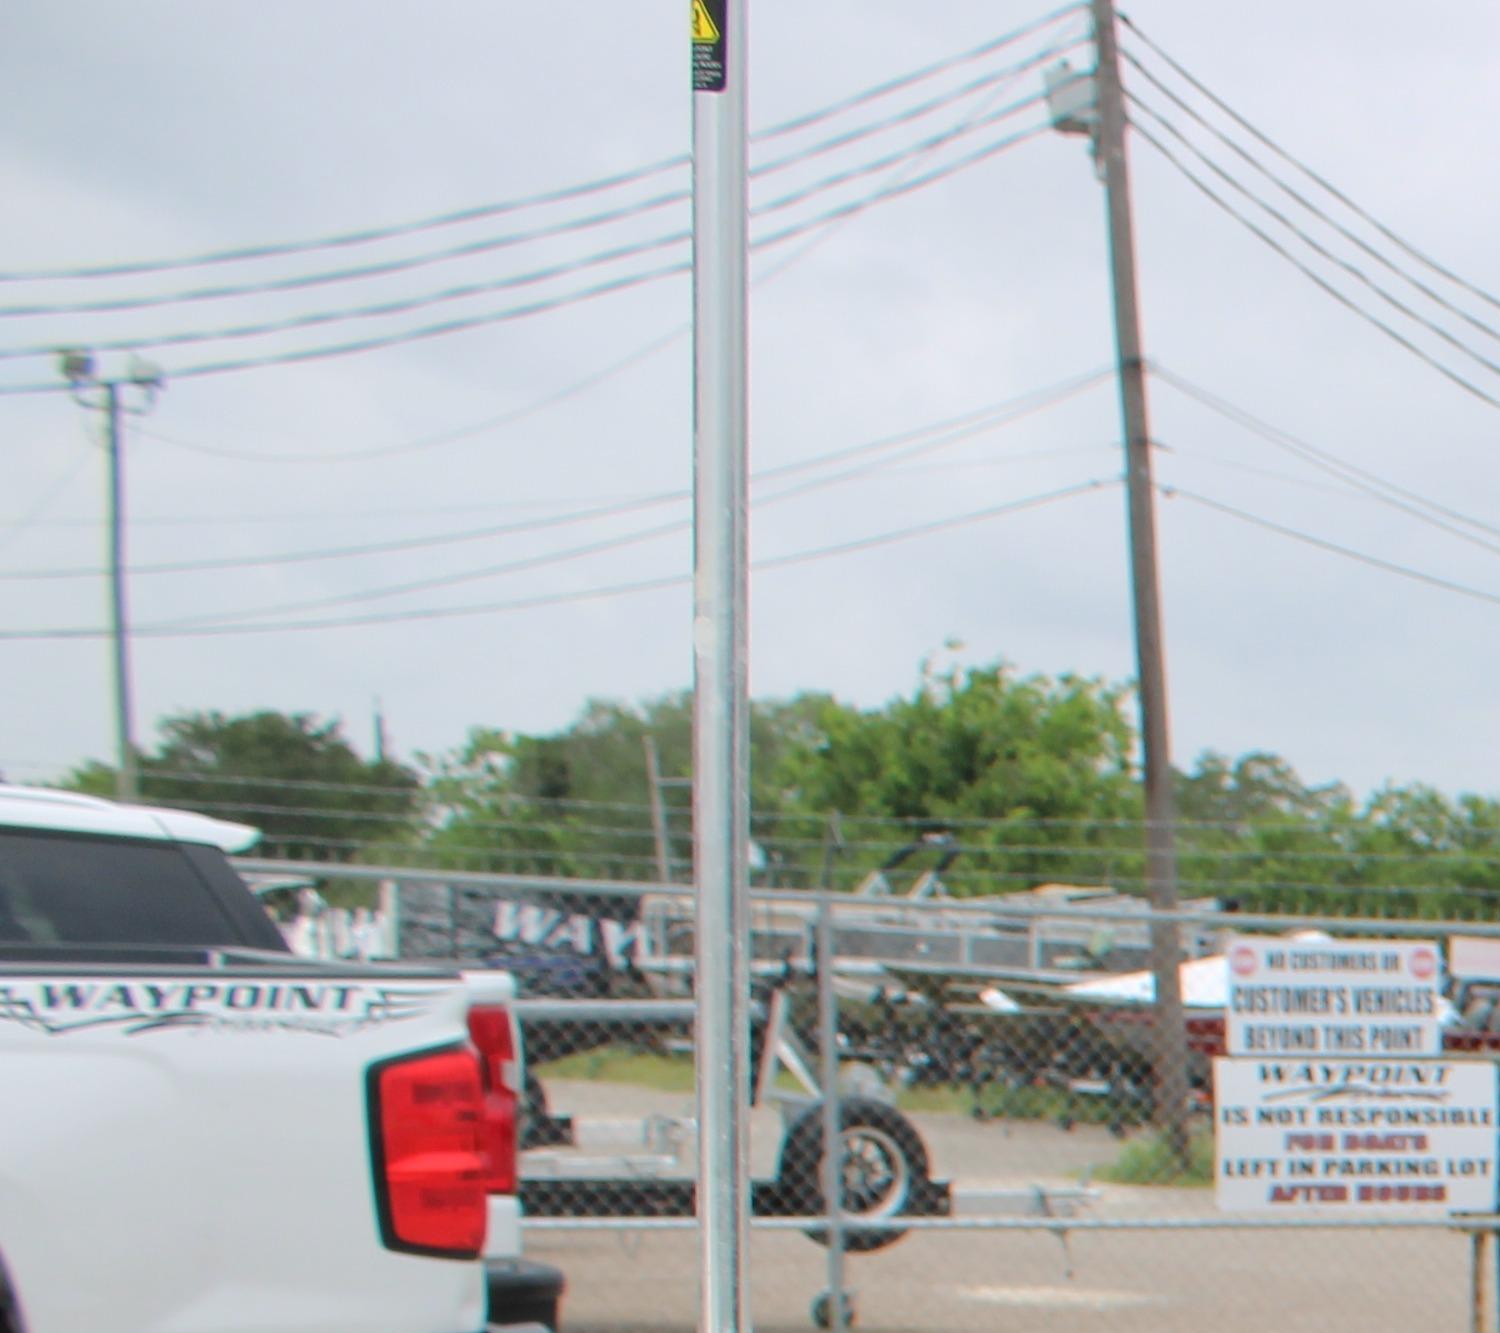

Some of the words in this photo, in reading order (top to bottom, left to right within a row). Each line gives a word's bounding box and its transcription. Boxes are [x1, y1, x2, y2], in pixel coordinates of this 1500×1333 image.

[1289, 951, 1377, 970] CUSTOMERS
[1381, 953, 1400, 971] OR
[42, 984, 363, 1011] WAYPOINT
[1233, 985, 1346, 1014] CUSTOMER'S
[1352, 986, 1434, 1015] VEHICLES
[1245, 1024, 1316, 1050] BEYOND
[1323, 1024, 1365, 1050] THIS
[1369, 1025, 1423, 1050] POINT
[1260, 1064, 1451, 1083] WAYPOINT
[1223, 1107, 1248, 1125] IS
[1258, 1107, 1308, 1125] NOT
[1318, 1106, 1492, 1125] RESPONSIBLE
[1286, 1132, 1334, 1151] FOR
[1344, 1132, 1428, 1151] BOATS
[1223, 1159, 1280, 1177] LEFT
[1290, 1159, 1314, 1176] IN
[1324, 1159, 1438, 1176] PARKING
[1447, 1158, 1491, 1175] LOT
[1270, 1184, 1348, 1203] AFTER
[1357, 1184, 1446, 1202] HOURS
